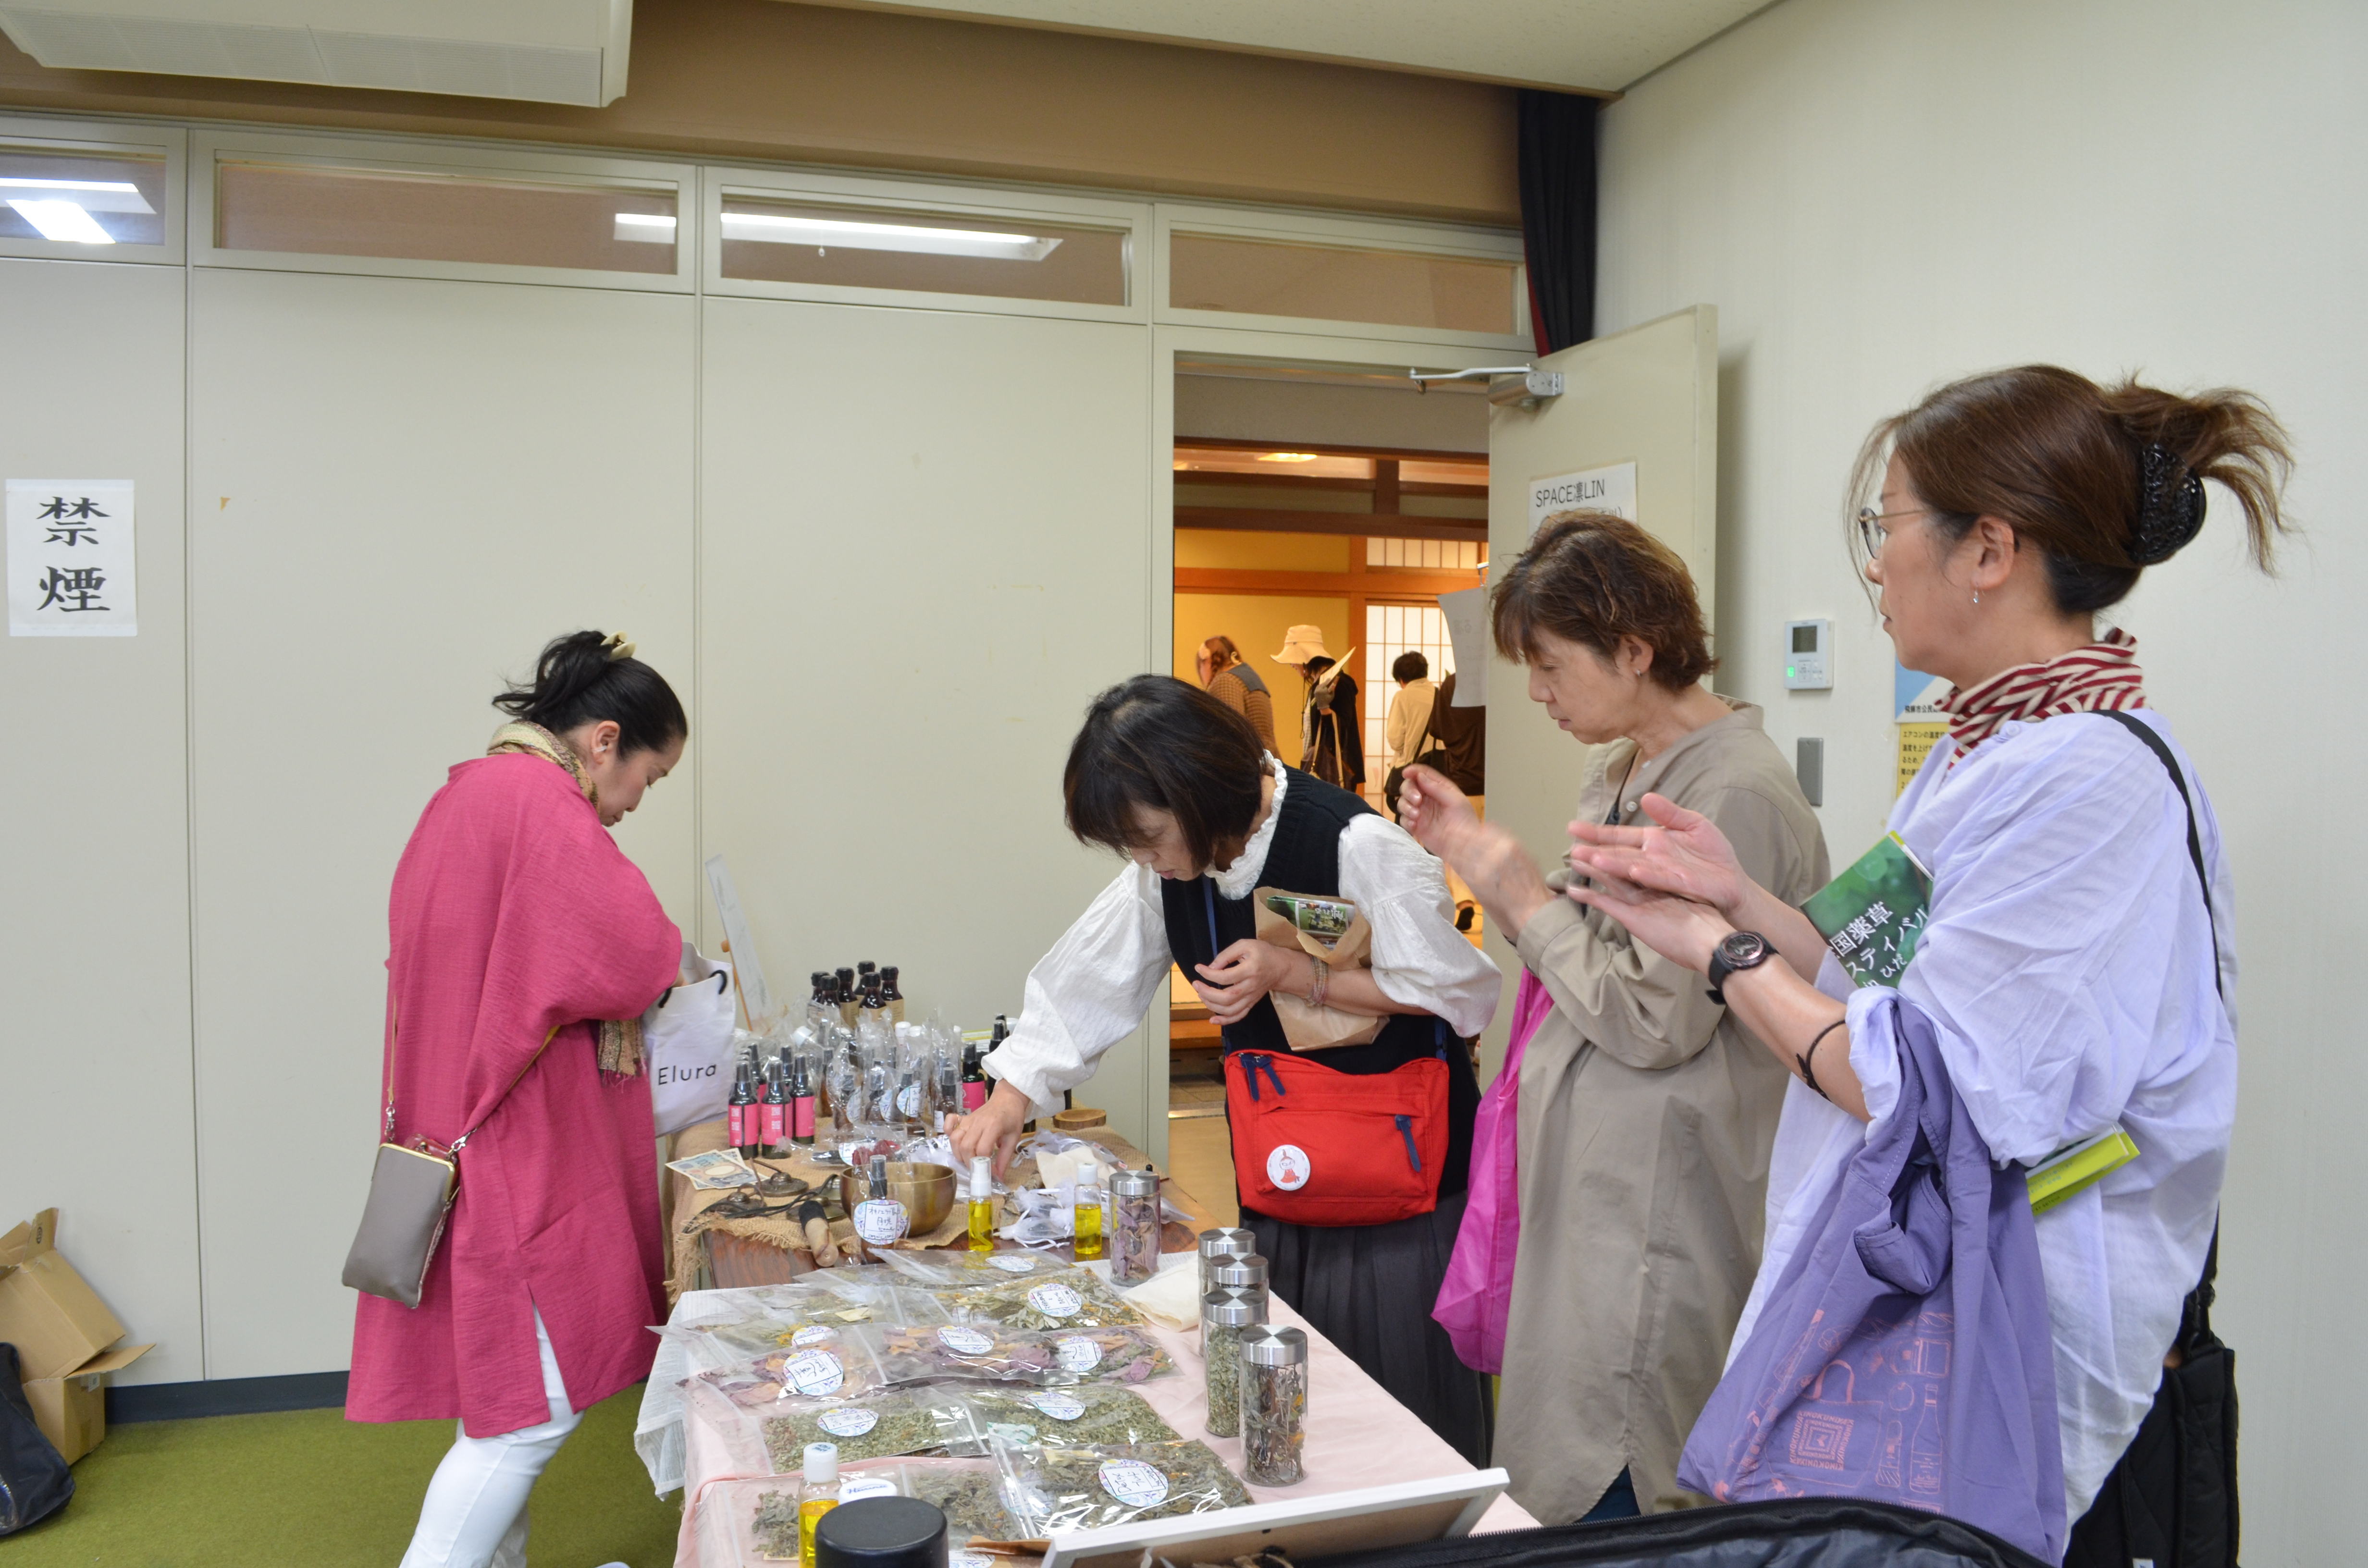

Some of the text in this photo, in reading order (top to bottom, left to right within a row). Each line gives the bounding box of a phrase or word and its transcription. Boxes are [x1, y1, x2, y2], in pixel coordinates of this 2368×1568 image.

[36, 496, 111, 612] 禁煙
[658, 1064, 716, 1086] Elura
[1789, 1417, 1803, 1463] KINOKUNIYA
